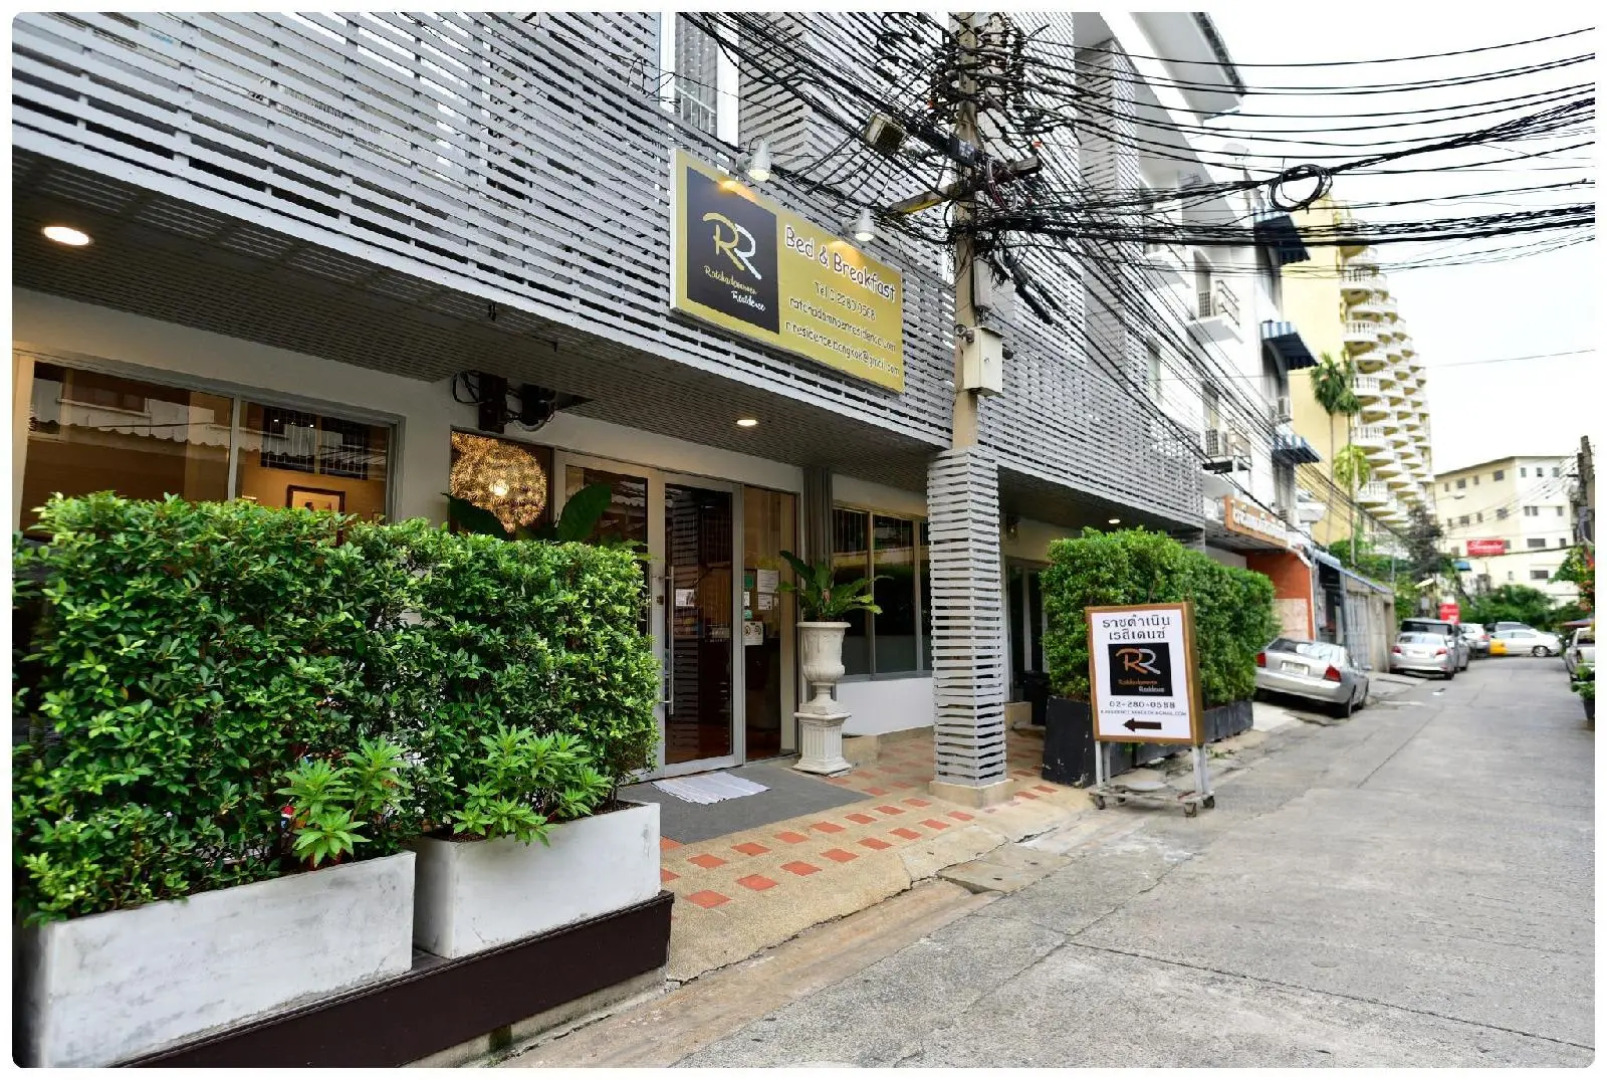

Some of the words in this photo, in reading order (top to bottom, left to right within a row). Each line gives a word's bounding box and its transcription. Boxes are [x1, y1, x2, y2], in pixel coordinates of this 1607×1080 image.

[785, 225, 815, 261] Bed
[818, 246, 830, 269] &
[833, 252, 896, 303] Breakfast
